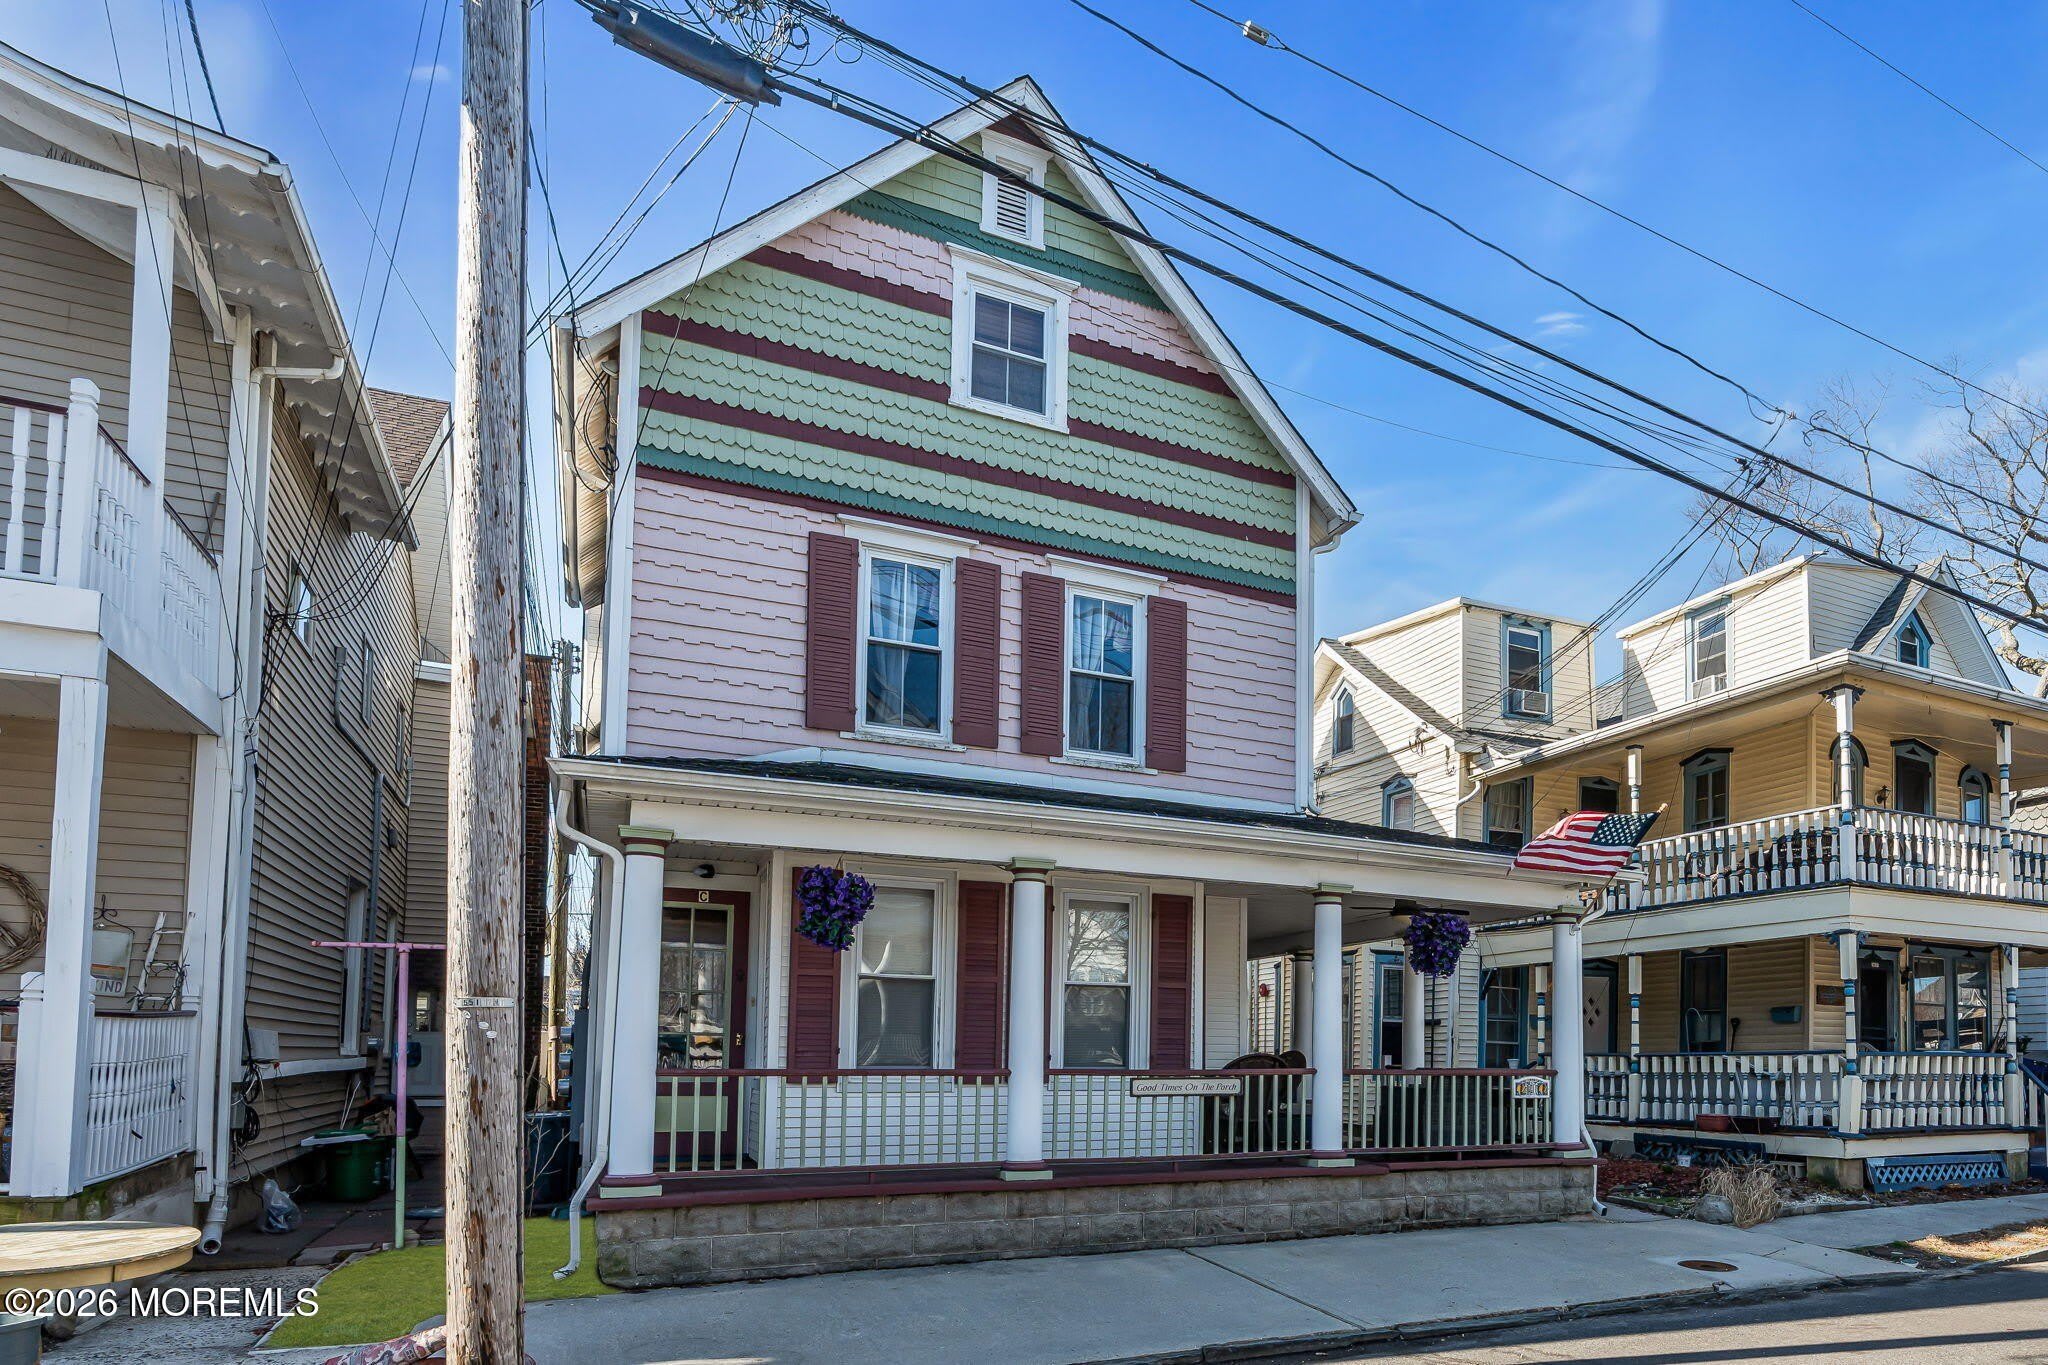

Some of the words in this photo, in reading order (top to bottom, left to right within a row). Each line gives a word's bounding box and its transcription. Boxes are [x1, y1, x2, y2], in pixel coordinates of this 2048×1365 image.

[700, 891, 708, 902] C
[1136, 1083, 1158, 1092] Good
[1160, 1083, 1183, 1092] Times
[1184, 1082, 1199, 1092] On
[1201, 1082, 1214, 1091] The
[1215, 1082, 1237, 1091] Porch
